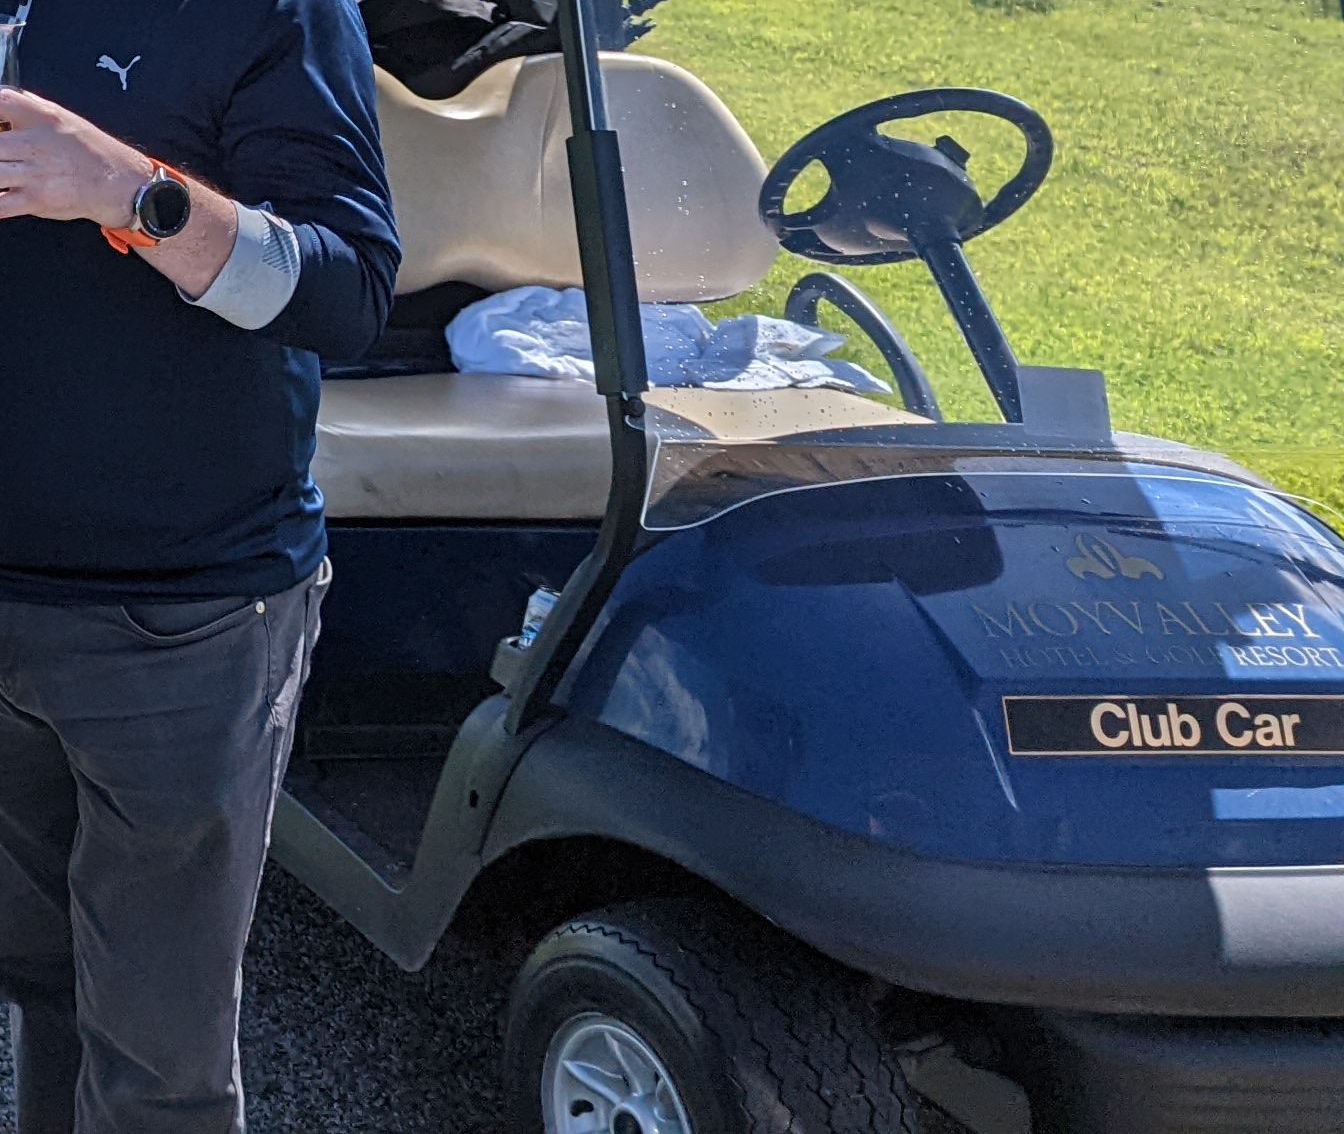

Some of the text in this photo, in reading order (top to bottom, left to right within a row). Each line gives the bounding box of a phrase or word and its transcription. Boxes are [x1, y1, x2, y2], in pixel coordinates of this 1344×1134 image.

[972, 601, 1322, 639] MOYVALLEY
[1227, 645, 1344, 668] RESORT
[1091, 702, 1301, 748] Club Car
